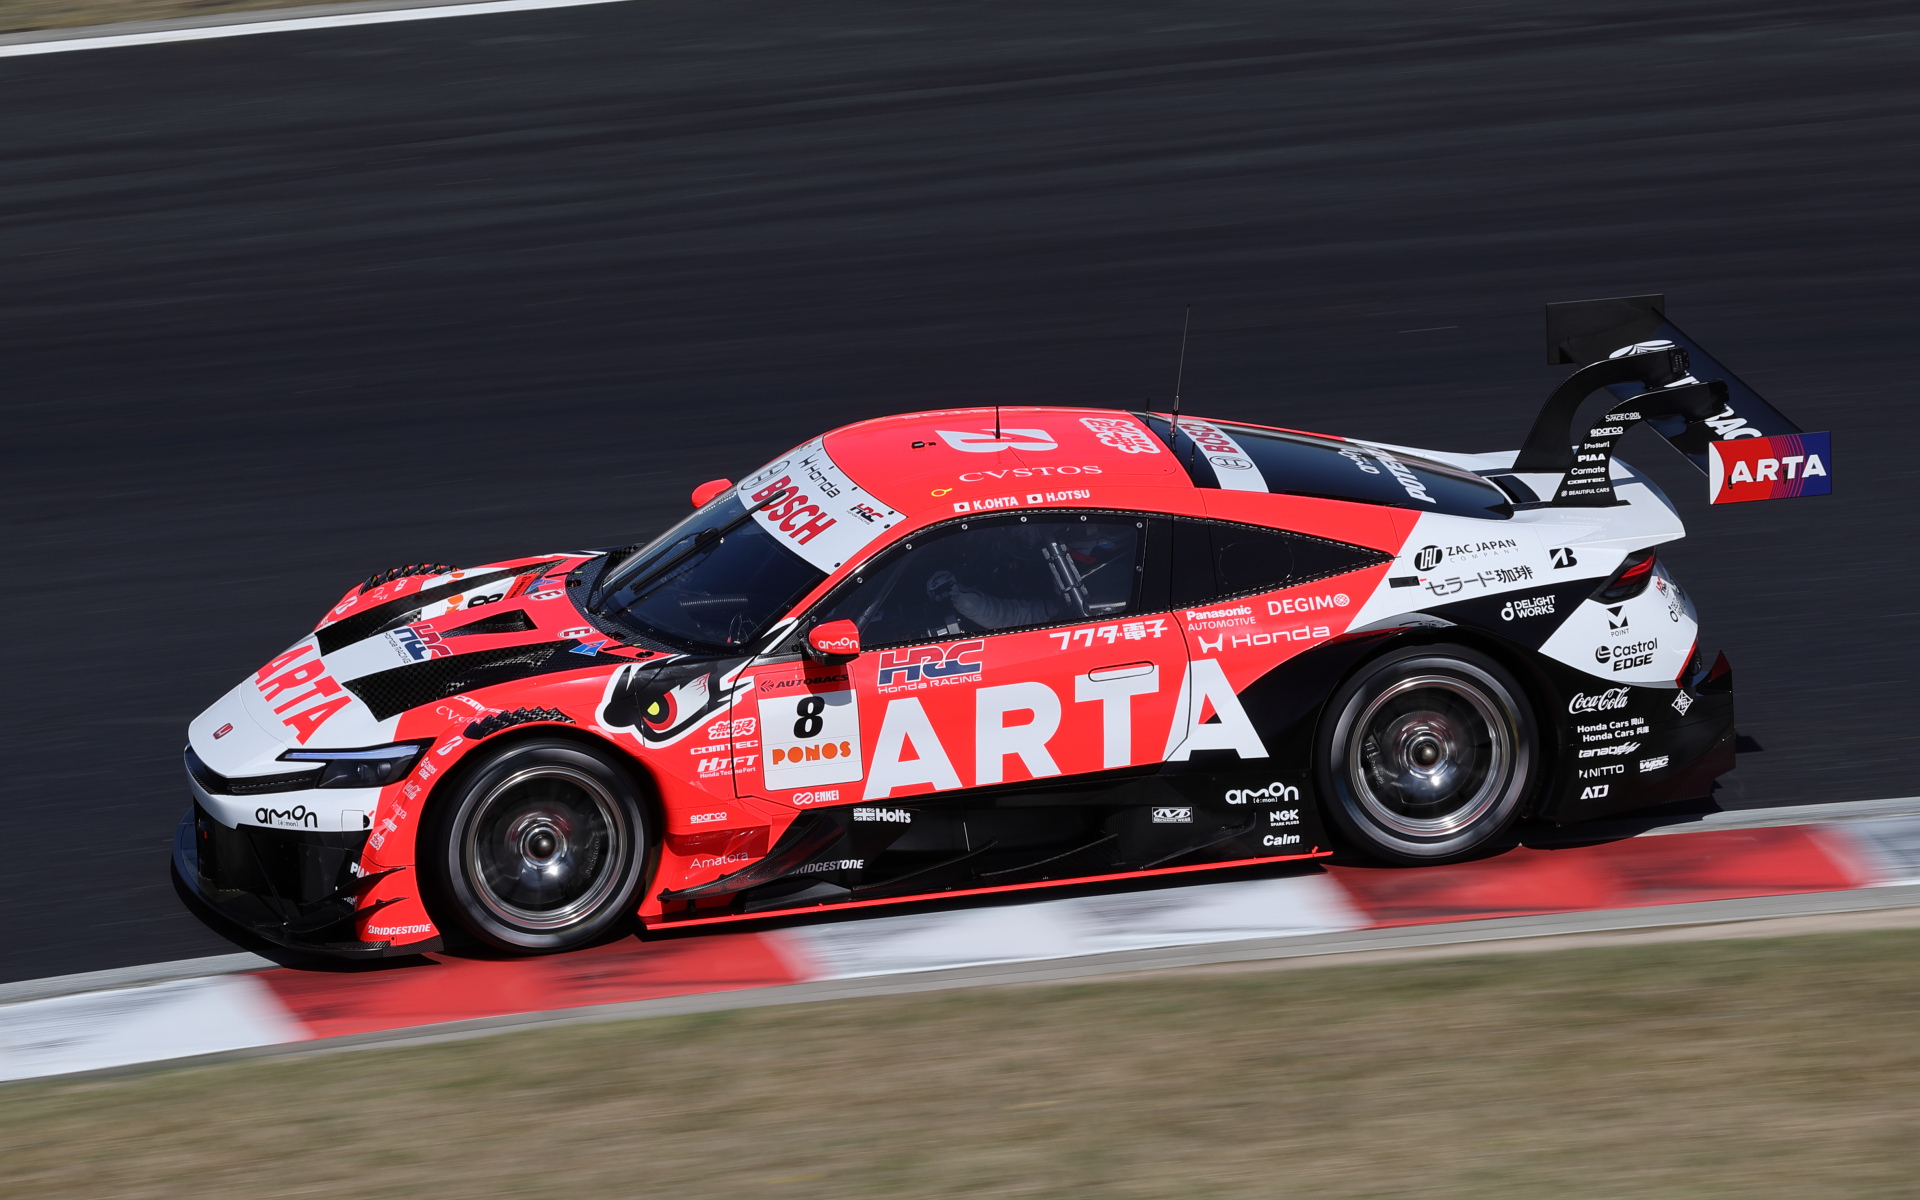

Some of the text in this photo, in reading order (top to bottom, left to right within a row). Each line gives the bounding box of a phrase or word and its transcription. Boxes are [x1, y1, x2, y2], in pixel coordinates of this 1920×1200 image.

[1590, 426, 1624, 437] sparco
[1578, 453, 1606, 462] PIAA
[1571, 466, 1606, 475] Carmate
[1731, 454, 1827, 484] ARTA
[804, 463, 841, 498] Honda
[1567, 477, 1606, 485] COMTEC
[1046, 489, 1091, 503] H.OTSU
[1568, 488, 1595, 496] BEAUTIFUL
[751, 475, 837, 546] BOSCH
[973, 497, 1019, 511] K.OHTA
[849, 503, 885, 523] HRC
[1445, 538, 1518, 558] ZAC JAPAN
[1449, 547, 1520, 564] COMPANY
[1425, 564, 1534, 597] セラード珈琲
[467, 593, 504, 608] 8
[1186, 604, 1252, 620] Panasonic
[1516, 604, 1555, 618] WORKS
[1187, 616, 1257, 632] AUTOMOTIVE
[1050, 618, 1169, 651] フクダ電子
[1232, 625, 1331, 649] Honda
[1610, 627, 1630, 638] POINT
[392, 624, 454, 661] HRC
[818, 637, 859, 650] amon
[1612, 637, 1658, 660] Castrol
[877, 639, 985, 689] HRC
[1613, 652, 1654, 672] EDGE
[775, 673, 849, 689] AUTOBACS
[929, 674, 983, 688] RACING
[255, 644, 353, 746] ARTA
[1568, 686, 1631, 714] Coca-Cola
[793, 695, 825, 739] 8
[862, 658, 1270, 801] ARTA
[1577, 723, 1607, 734] Honda
[1609, 720, 1629, 729] Cars
[1583, 732, 1613, 743] Honda
[1614, 729, 1635, 738] Cars
[690, 740, 759, 755] COMTEC
[772, 741, 852, 765] PONOS
[1589, 764, 1625, 778] NITTO
[814, 789, 840, 803] ENKEI
[1225, 781, 1299, 805] amon
[255, 805, 318, 828] amon
[690, 811, 728, 824] sparco
[875, 807, 912, 824] Holts
[1269, 809, 1300, 822] NGK
[1263, 834, 1300, 847] Calm
[690, 850, 749, 870] Amatora
[790, 858, 865, 876] RIDGESTONE
[367, 924, 432, 936] BRIDGESTONE
